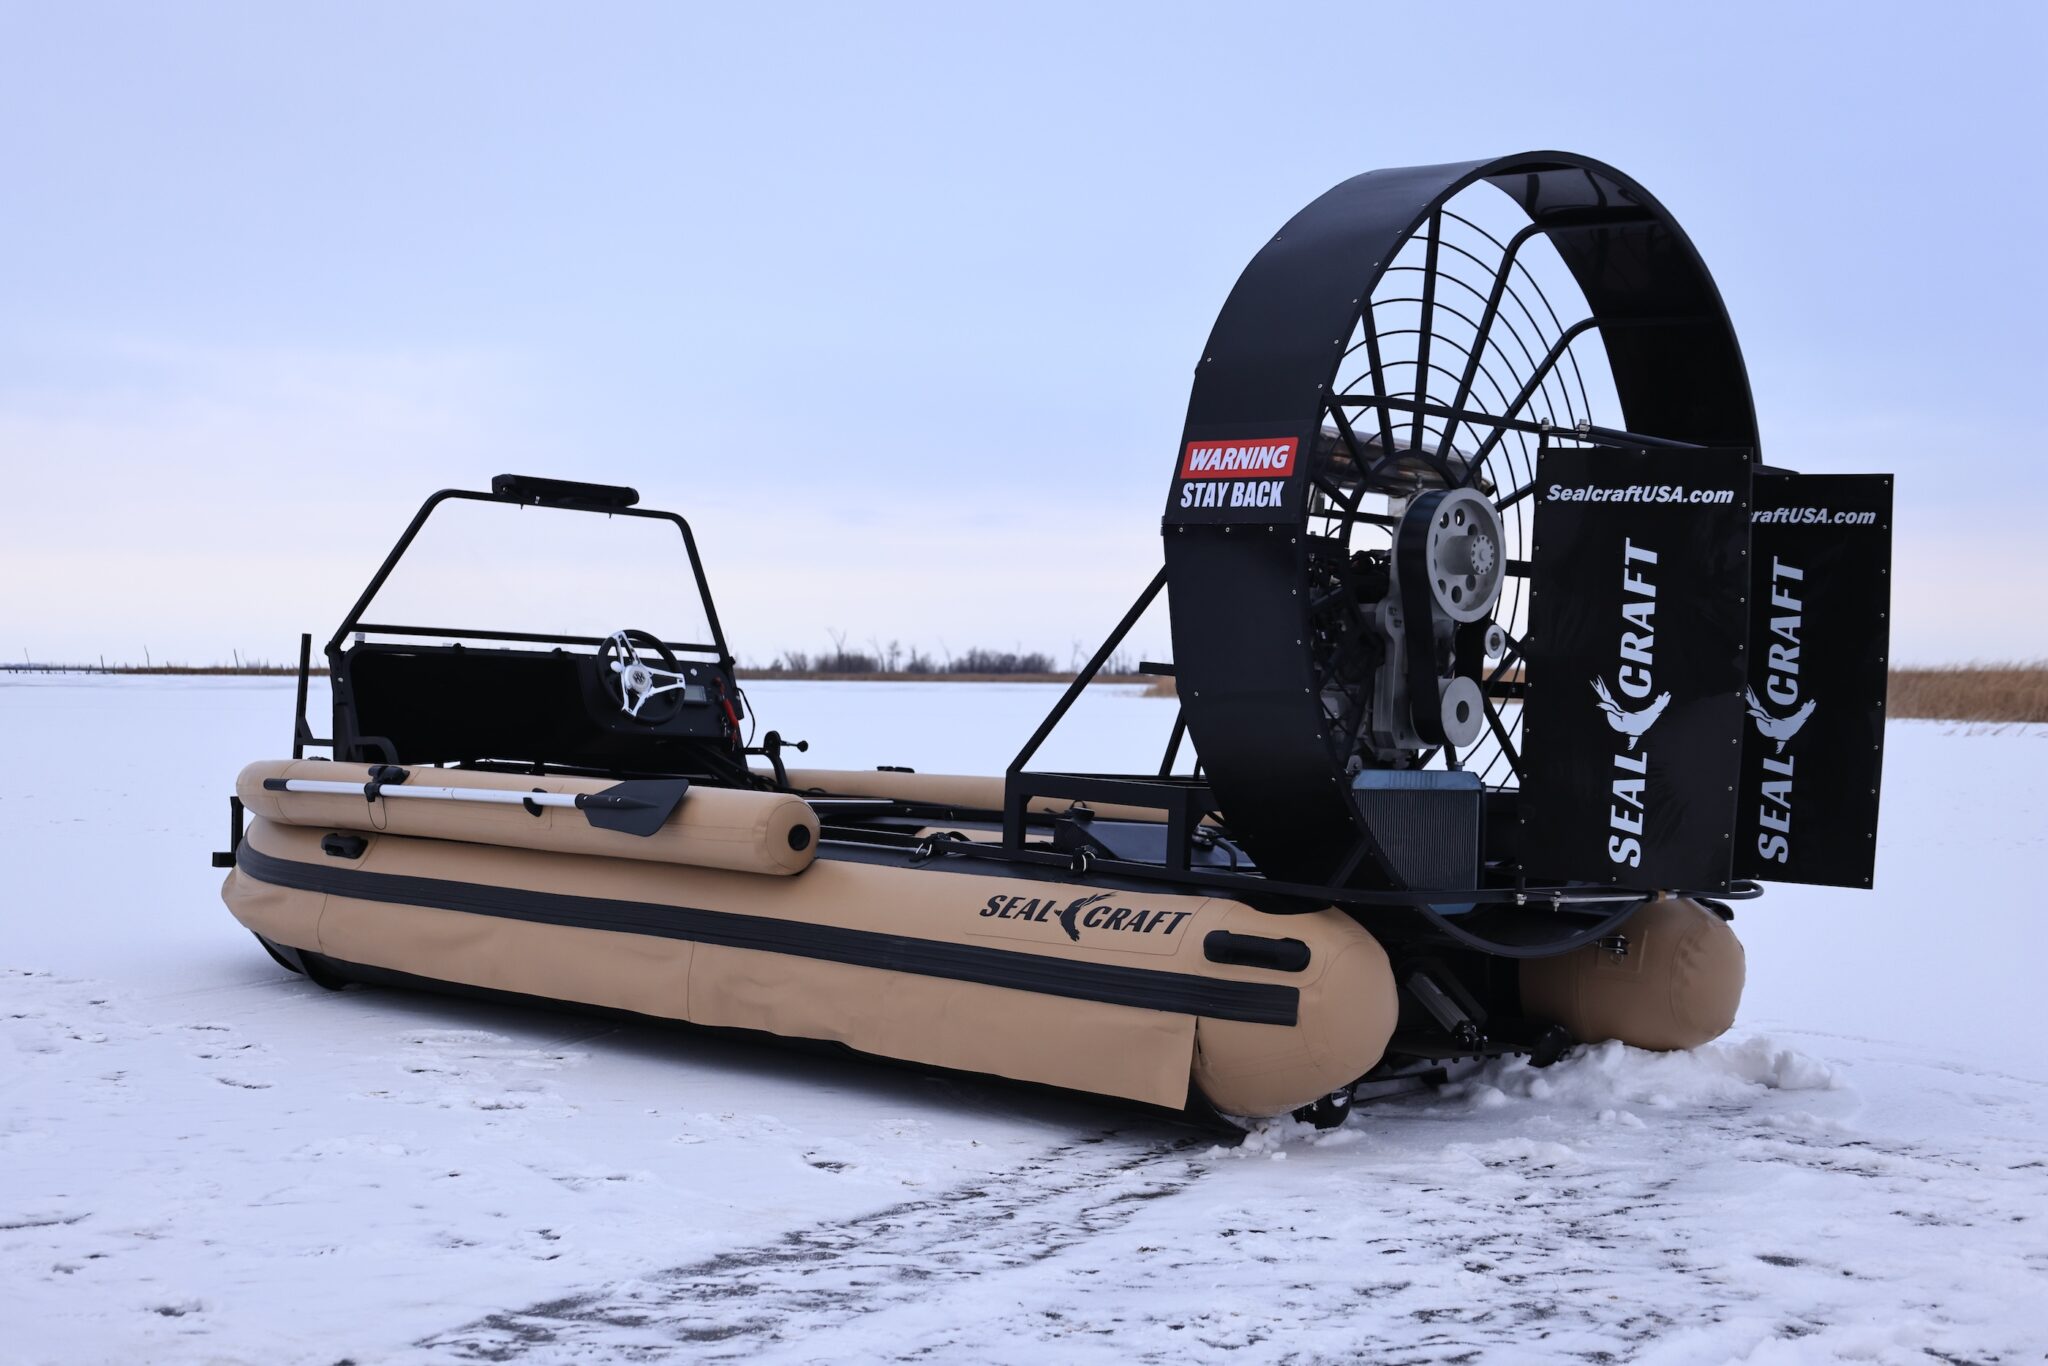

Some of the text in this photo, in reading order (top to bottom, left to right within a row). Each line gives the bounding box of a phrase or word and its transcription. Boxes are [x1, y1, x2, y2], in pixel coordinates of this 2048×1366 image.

[1189, 444, 1291, 471] WARNING
[1180, 480, 1285, 508] STAY BACK
[1546, 484, 1735, 504] SealcraftUSA.com
[1751, 507, 1877, 525] raftUSA.com
[1608, 536, 1658, 869] SEAL CRAFT
[1757, 555, 1804, 864] SEAL CRAFT
[979, 894, 1193, 935] SEAL CRAFT
